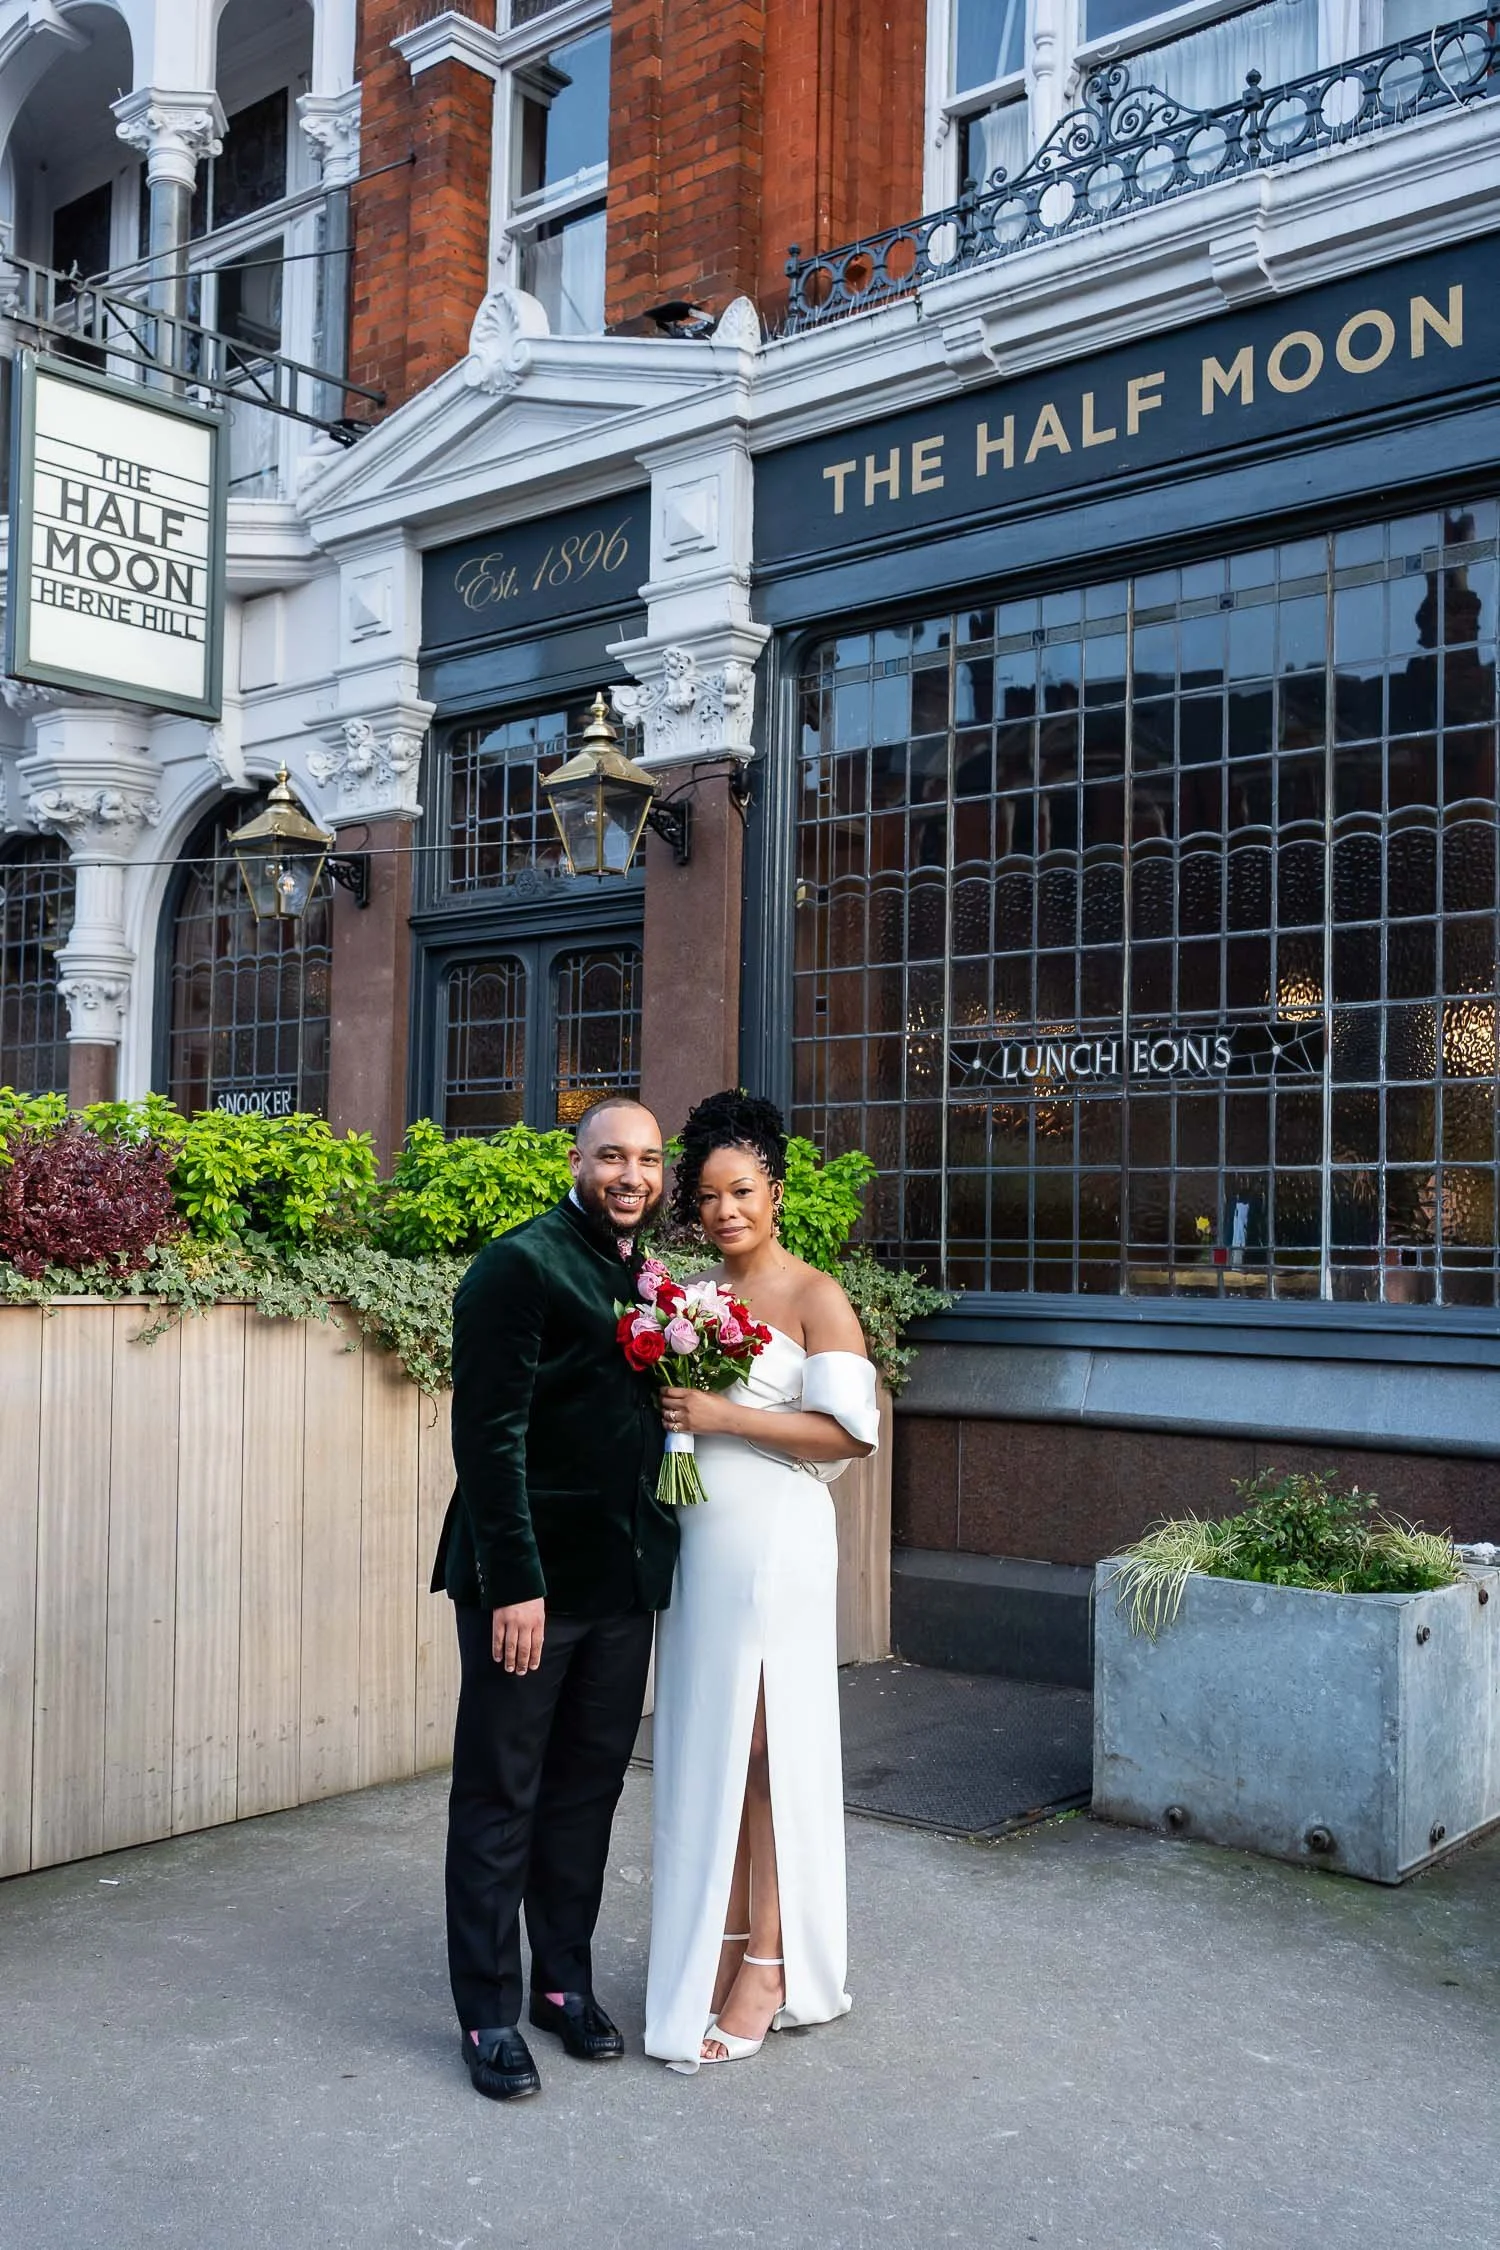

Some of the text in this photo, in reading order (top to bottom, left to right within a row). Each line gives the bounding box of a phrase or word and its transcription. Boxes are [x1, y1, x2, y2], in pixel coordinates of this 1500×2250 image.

[823, 284, 1464, 514] THE HALF MOON
[96, 452, 151, 493] THE
[60, 478, 185, 549] HALF
[47, 526, 193, 604] MOON
[454, 516, 633, 613] Est. 1896
[40, 578, 197, 641] HERNE HILL
[217, 1090, 291, 1116] SNOOKER
